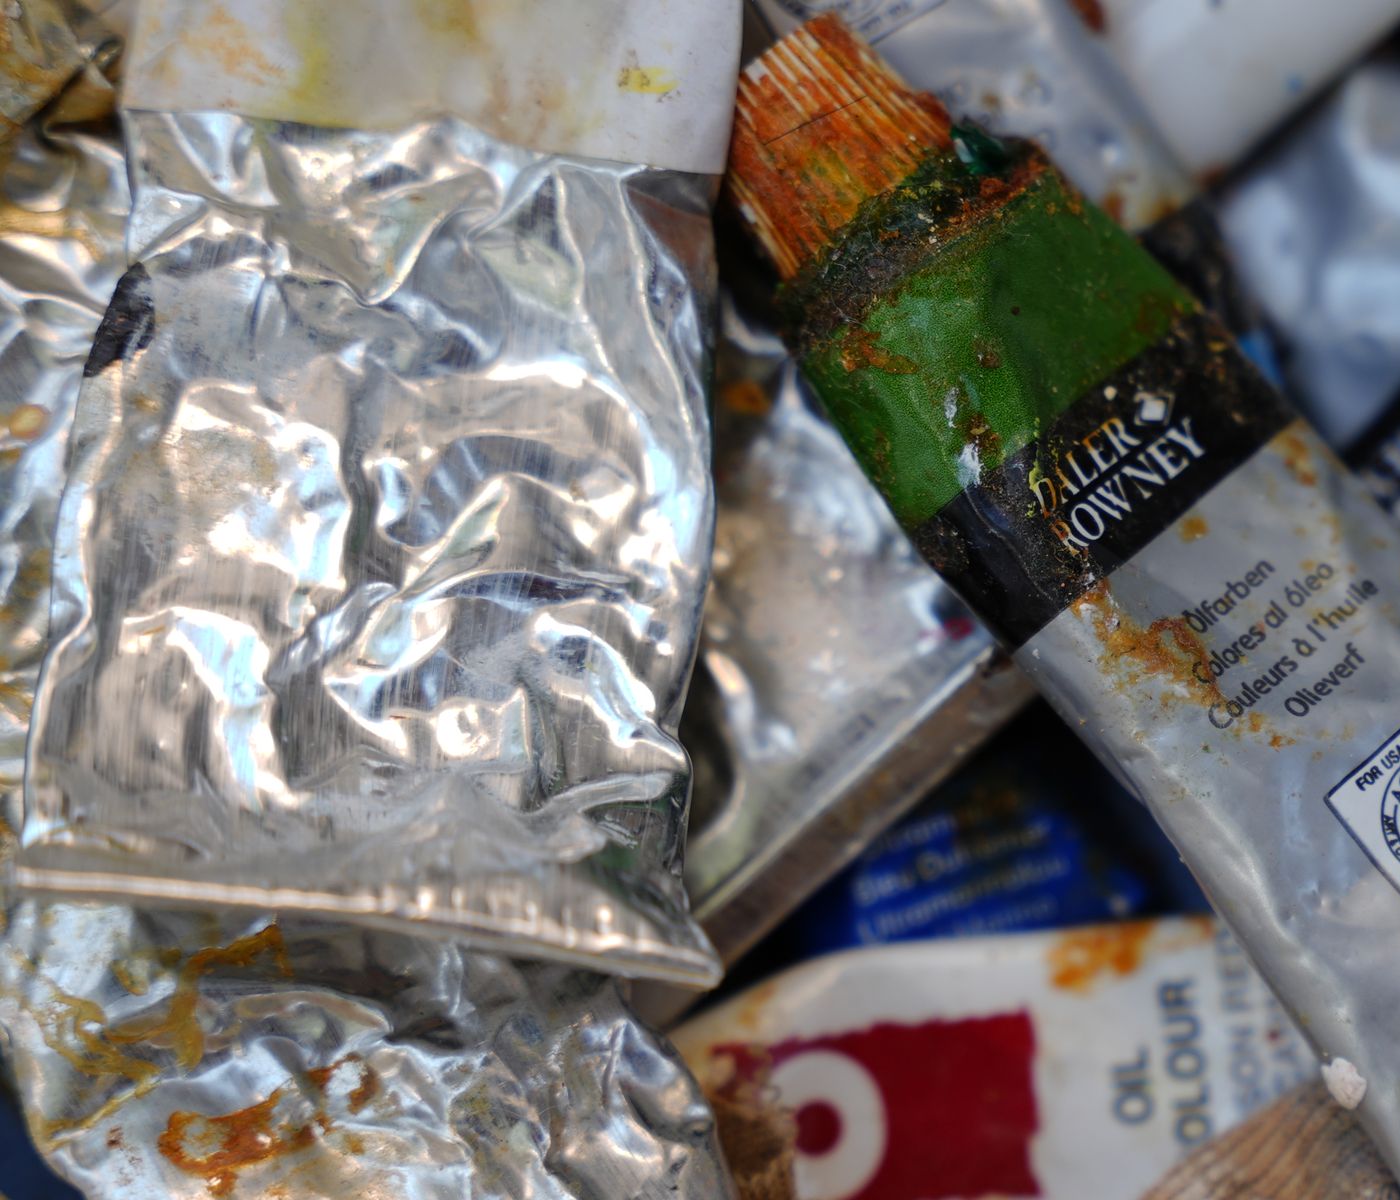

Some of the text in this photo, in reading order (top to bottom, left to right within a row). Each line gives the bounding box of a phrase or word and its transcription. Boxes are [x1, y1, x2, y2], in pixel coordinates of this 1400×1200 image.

[1034, 416, 1141, 518] DALER
[1050, 417, 1206, 554] ROWNEY
[1183, 558, 1276, 635] Ölfarben
[1191, 561, 1335, 684] Colores al óleo
[1208, 577, 1380, 730] Couleurs à l'huile
[1284, 642, 1367, 718] Olieverf
[1355, 766, 1383, 792] FOR
[1113, 1047, 1156, 1127] OIL
[1158, 978, 1216, 1148] OLOUR
